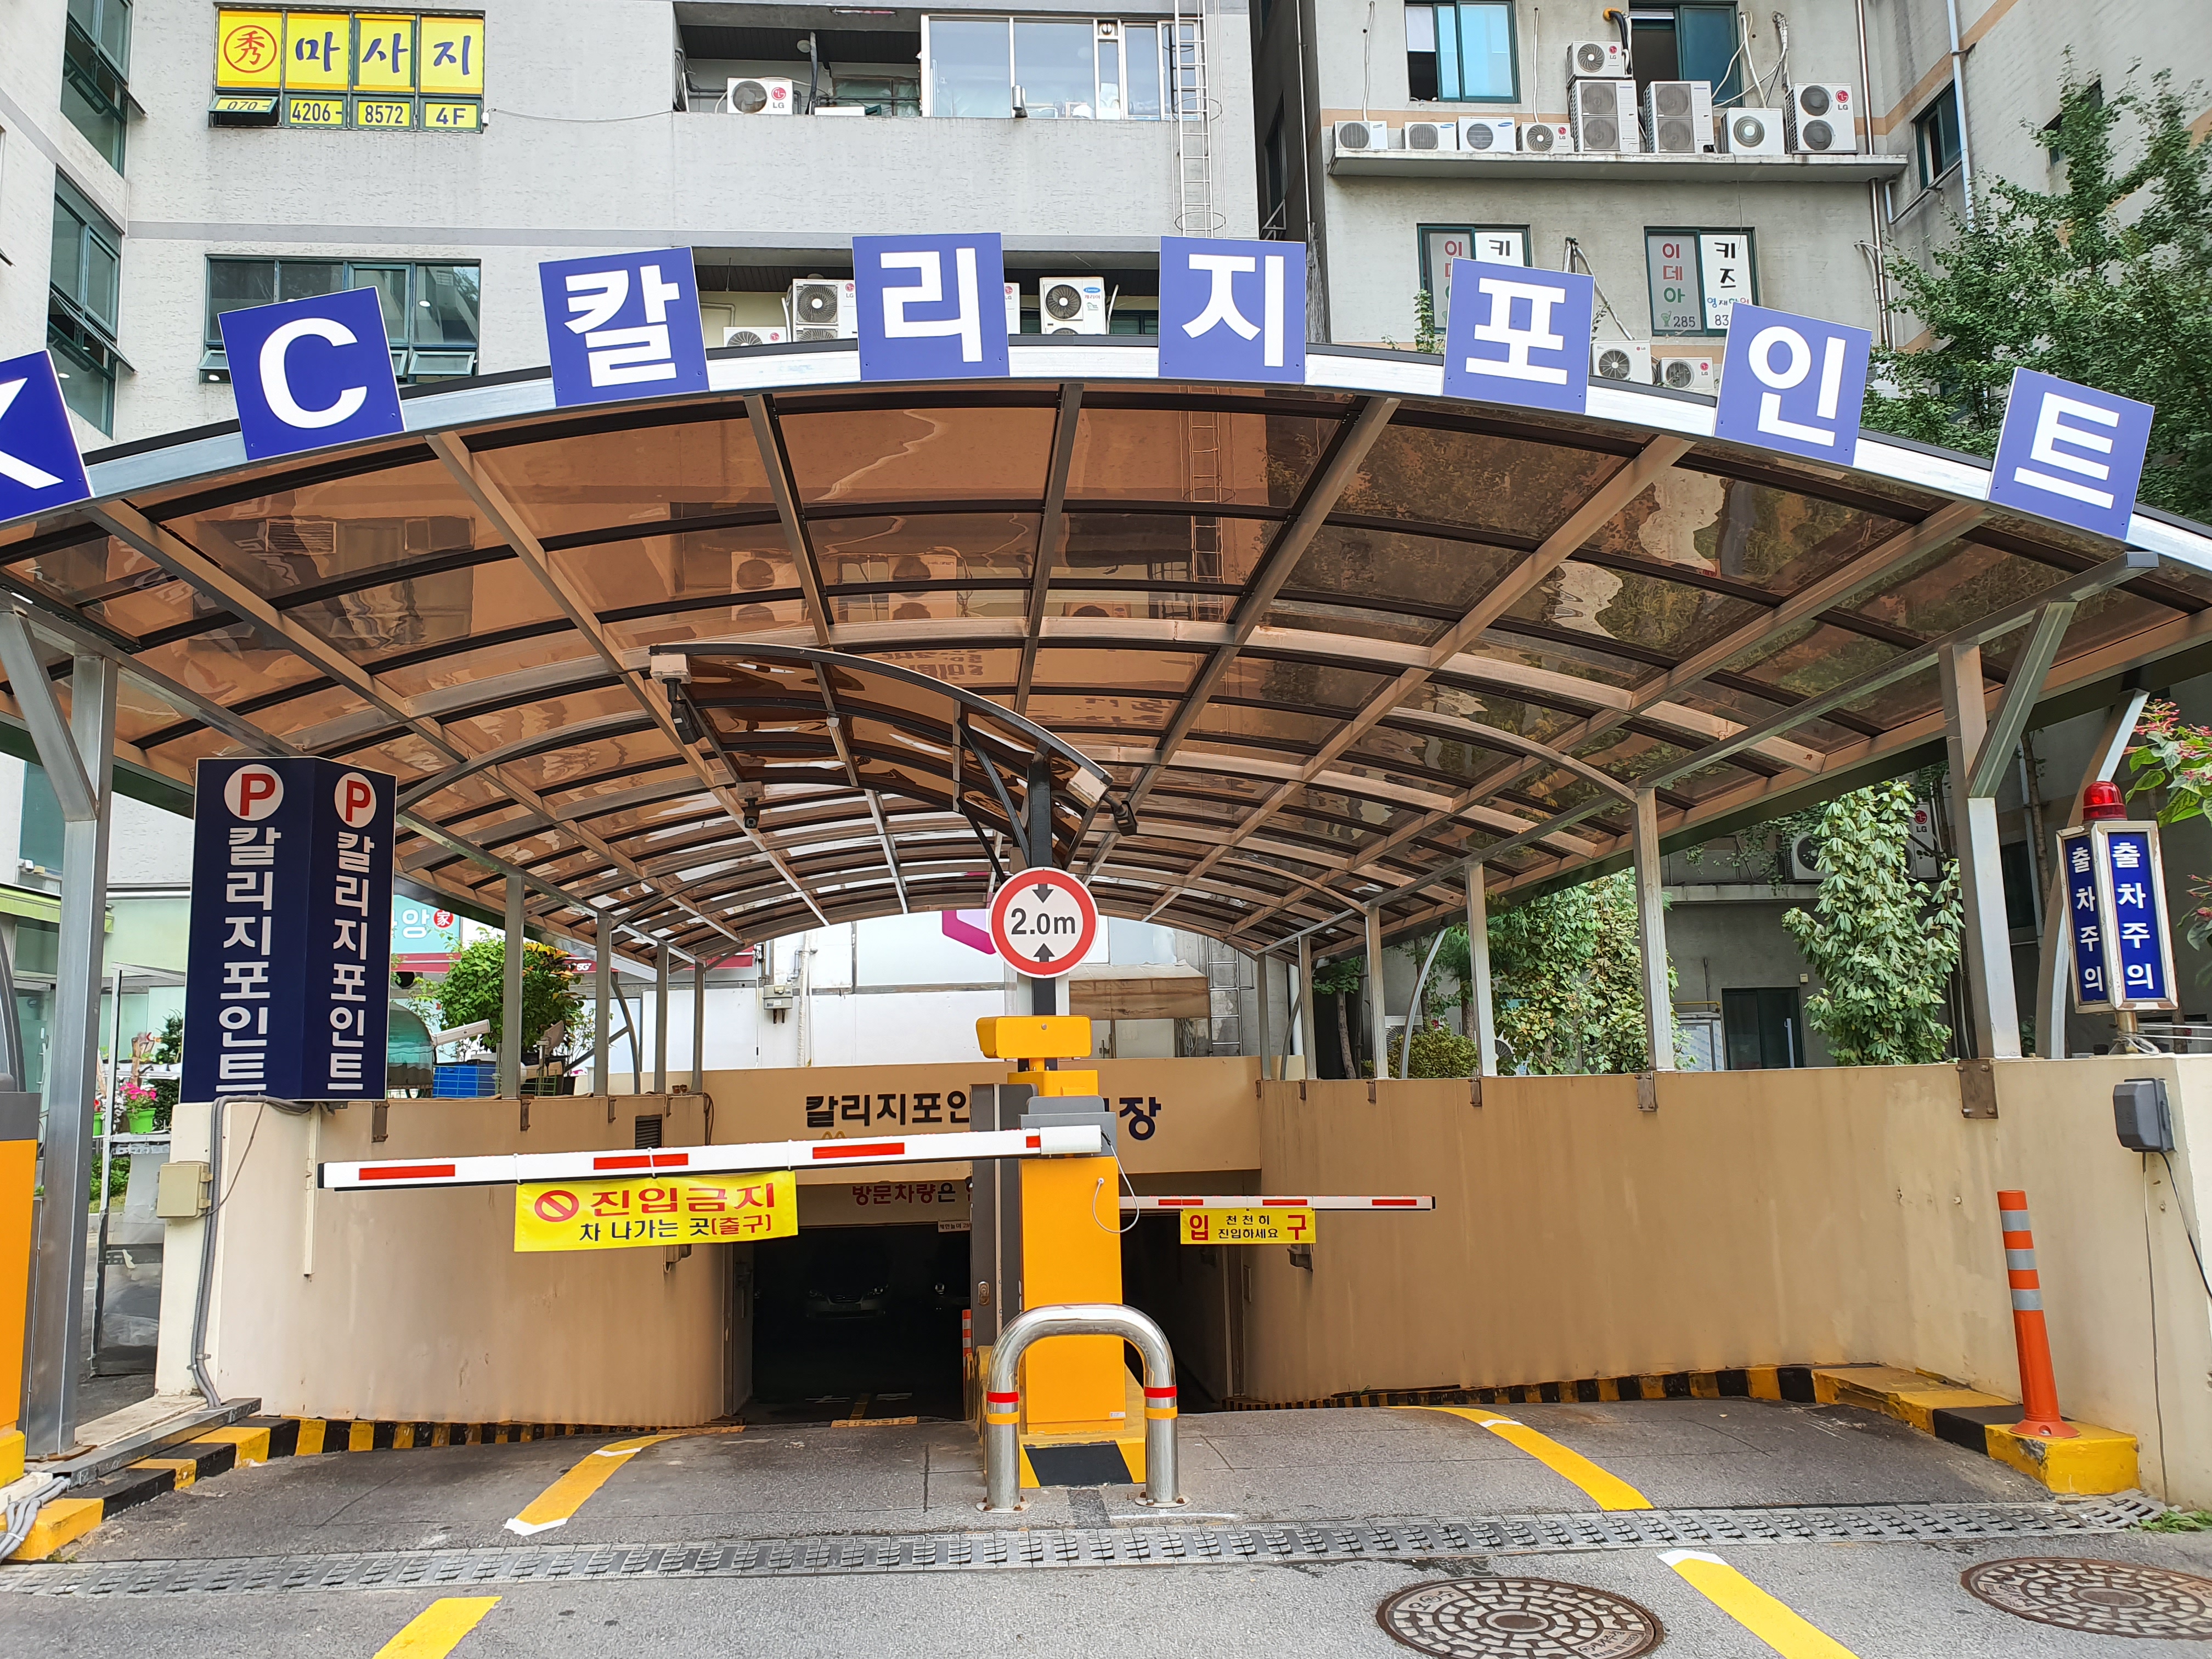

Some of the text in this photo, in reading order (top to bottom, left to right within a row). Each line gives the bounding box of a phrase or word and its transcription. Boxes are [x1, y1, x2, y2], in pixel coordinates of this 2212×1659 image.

[234, 30, 266, 66] 秀
[295, 31, 472, 76] 마사지
[365, 104, 403, 124] 8572
[436, 107, 466, 125] 4F
[1673, 316, 1696, 328] 285
[239, 774, 275, 816] P
[346, 780, 371, 822] P
[1011, 908, 1076, 935] 2.0m
[2072, 847, 2103, 992] 출차주의
[2112, 843, 2154, 990] 출차주의
[216, 827, 281, 1092] 칼리지포인트
[328, 831, 375, 1091] 칼리지포인트
[590, 1183, 775, 1217] 진입금지
[853, 1182, 956, 1206] 방문차량은
[579, 1223, 601, 1242] 차
[612, 1219, 679, 1240] 나가는
[1218, 1228, 1279, 1239] 진입하세요
